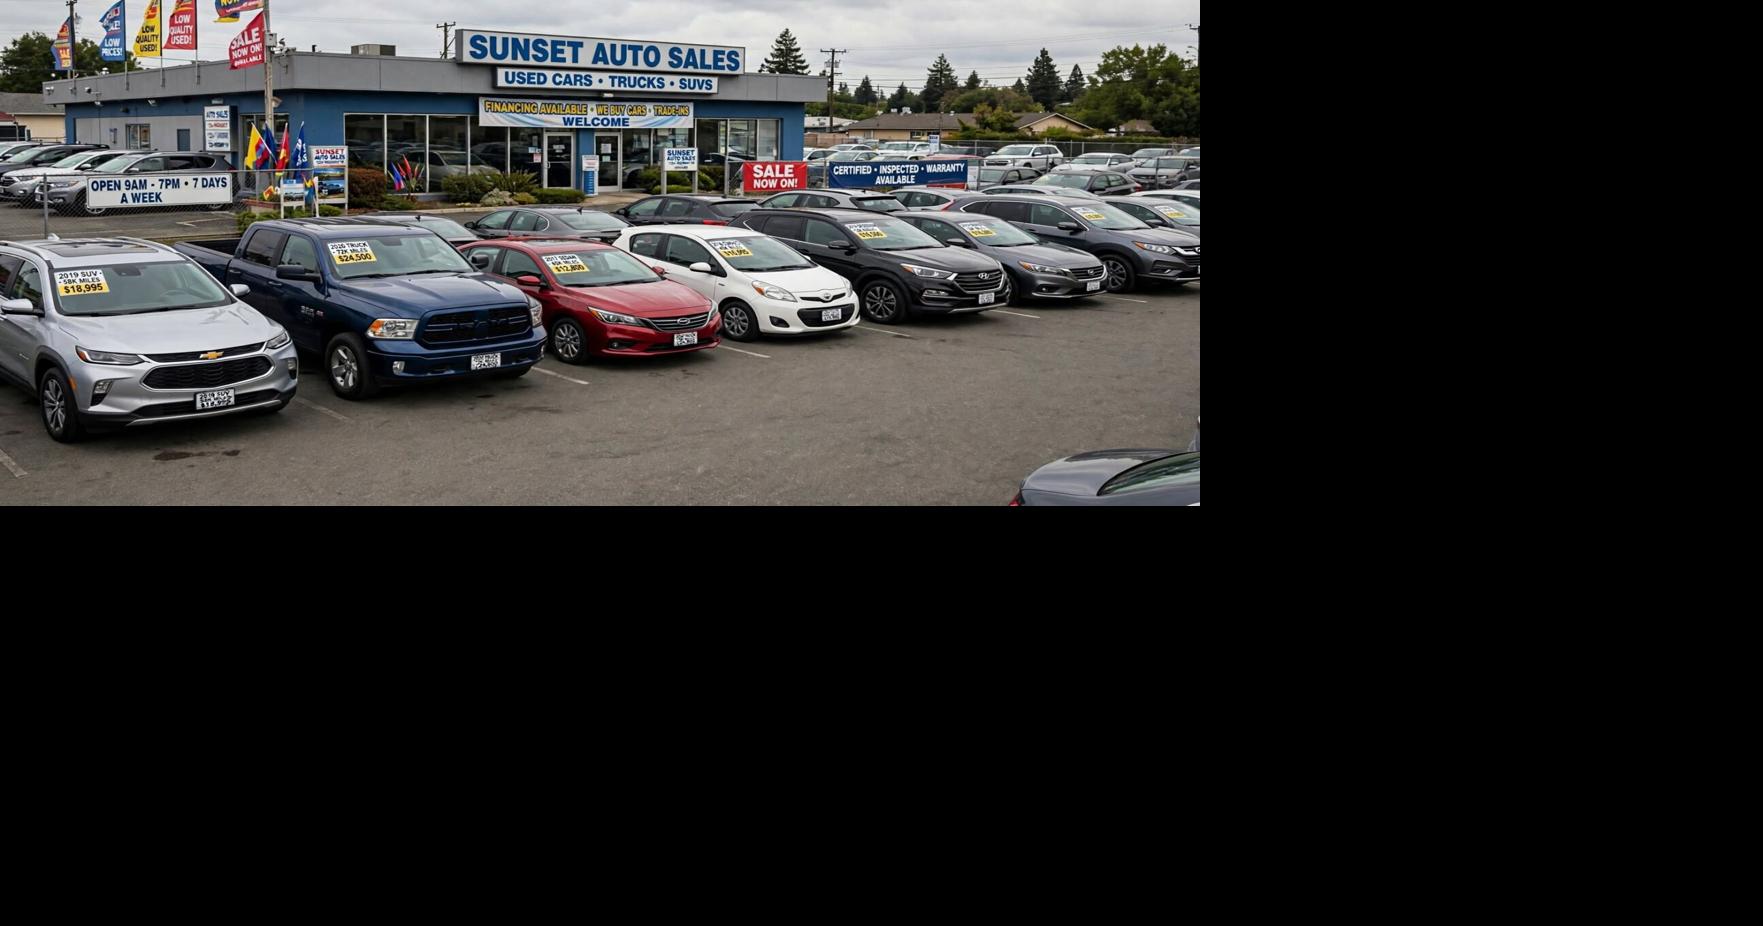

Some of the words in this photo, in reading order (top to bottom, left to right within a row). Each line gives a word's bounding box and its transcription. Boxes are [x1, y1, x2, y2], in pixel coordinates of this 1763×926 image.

[174, 14, 191, 24] LOW
[141, 25, 155, 33] LOW
[170, 25, 193, 35] QUALITY
[104, 38, 120, 47] LOW
[136, 34, 159, 43] QUALITY
[170, 35, 192, 45] USED!
[231, 27, 261, 50] SALE
[101, 47, 122, 56] PRICES!
[140, 44, 158, 52] USED!
[232, 47, 249, 59] NOW
[249, 43, 263, 53] ON!
[469, 34, 584, 64] SUNSET
[591, 42, 661, 68] AUTO
[668, 46, 741, 72] SALES
[504, 71, 547, 85] USED
[552, 73, 593, 87] CARS
[608, 75, 666, 89] TRUCKS
[679, 77, 713, 90] SUVS
[484, 100, 538, 113] FINANCING
[539, 103, 588, 115] AVAILABLE
[595, 104, 609, 116] WE
[610, 104, 626, 116] BUY
[626, 105, 647, 116] CARS
[653, 105, 690, 116] TRADE-INS
[562, 117, 630, 127] WELCOME
[752, 164, 795, 178] SALE
[833, 165, 872, 175] CERTIFIED
[879, 165, 919, 174] INSPECTED
[926, 163, 965, 173] WARRANTY
[91, 180, 121, 191] OPEN
[124, 179, 148, 190] 9AM
[158, 178, 180, 189] 7PM
[193, 178, 199, 188] 7
[201, 177, 227, 188] DAYS
[753, 179, 778, 189] NOW
[780, 179, 798, 188] ON!
[875, 175, 916, 185] AVAILABLE
[120, 193, 128, 204] A
[131, 192, 162, 203] WEEK
[338, 253, 372, 262] $24,500
[64, 283, 104, 293] $18,995
